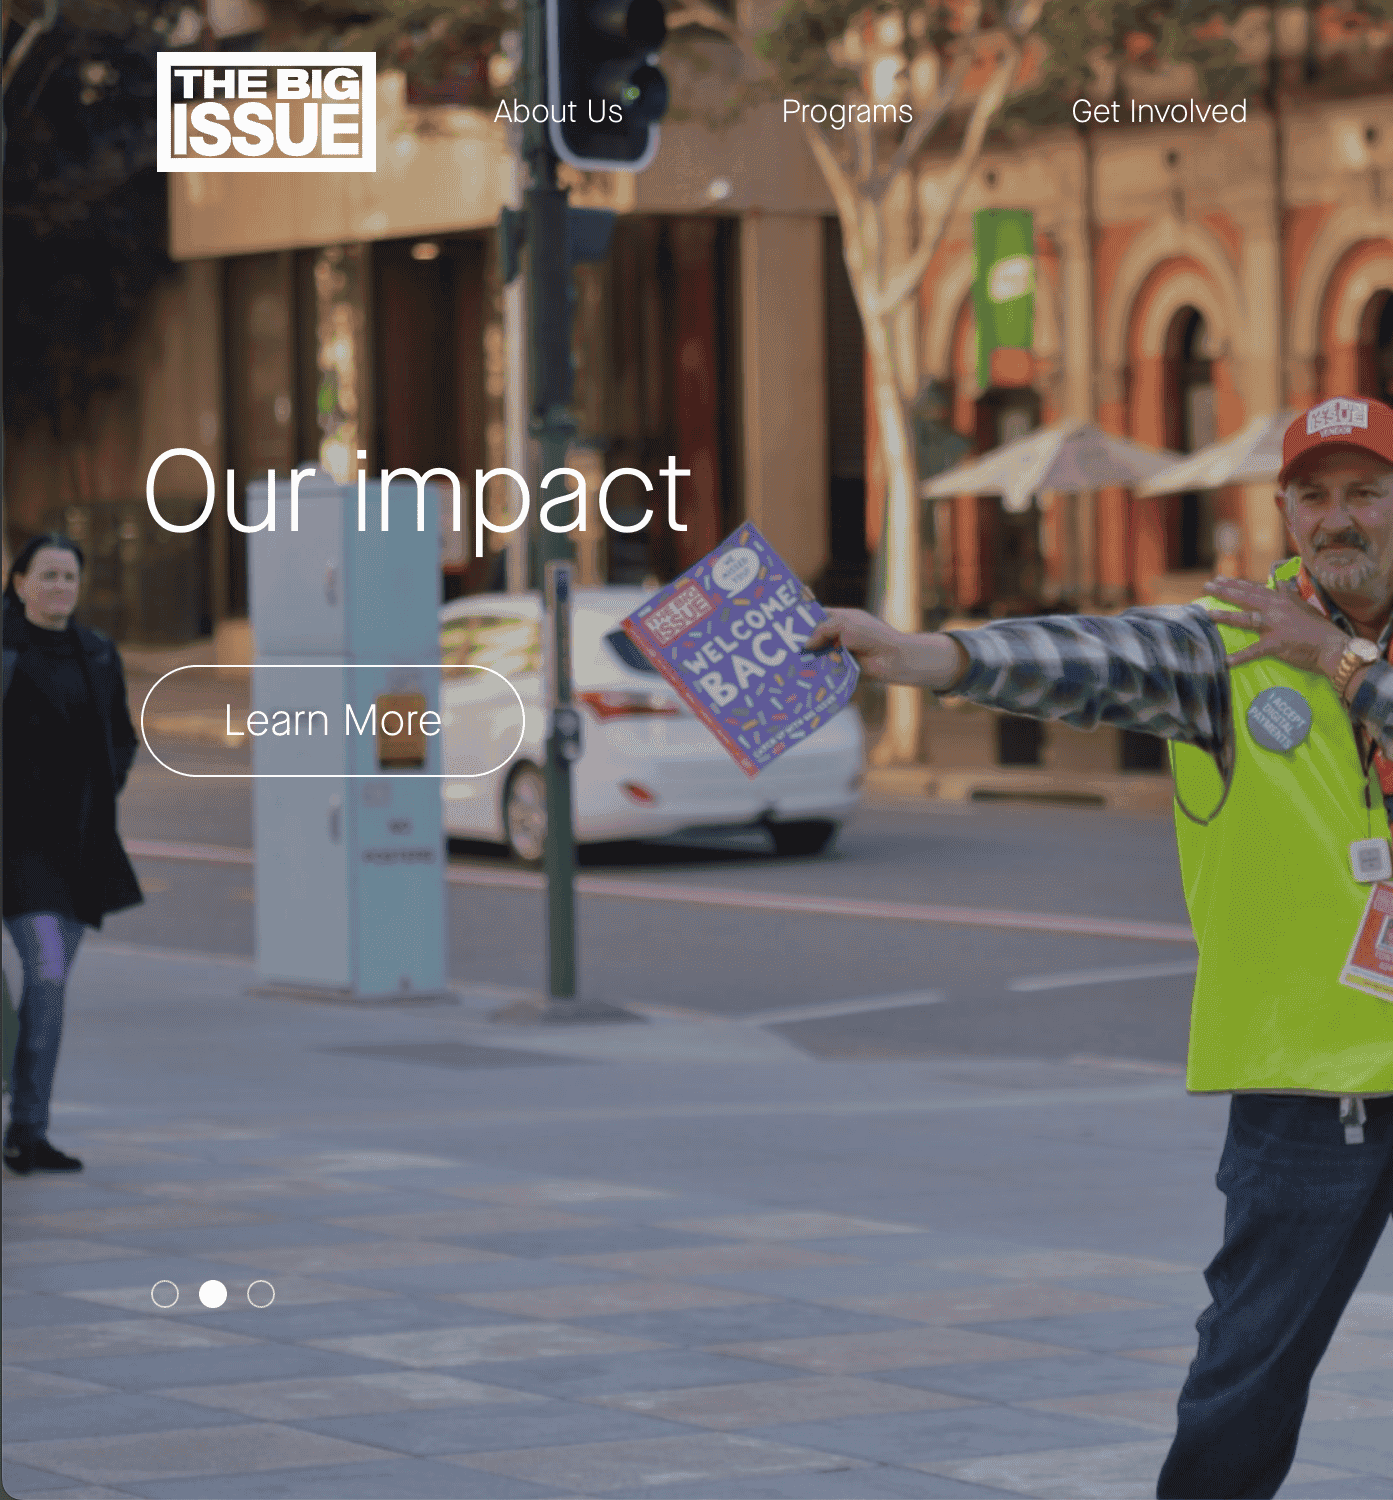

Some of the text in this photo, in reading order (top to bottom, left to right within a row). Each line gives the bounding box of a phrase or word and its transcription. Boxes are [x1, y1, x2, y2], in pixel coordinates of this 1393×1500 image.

[683, 579, 797, 674] WELCOME!
[1248, 705, 1294, 750] PAYMENTS
[1261, 702, 1294, 736] DIGITAL
[1272, 696, 1307, 729] ACCEPT
